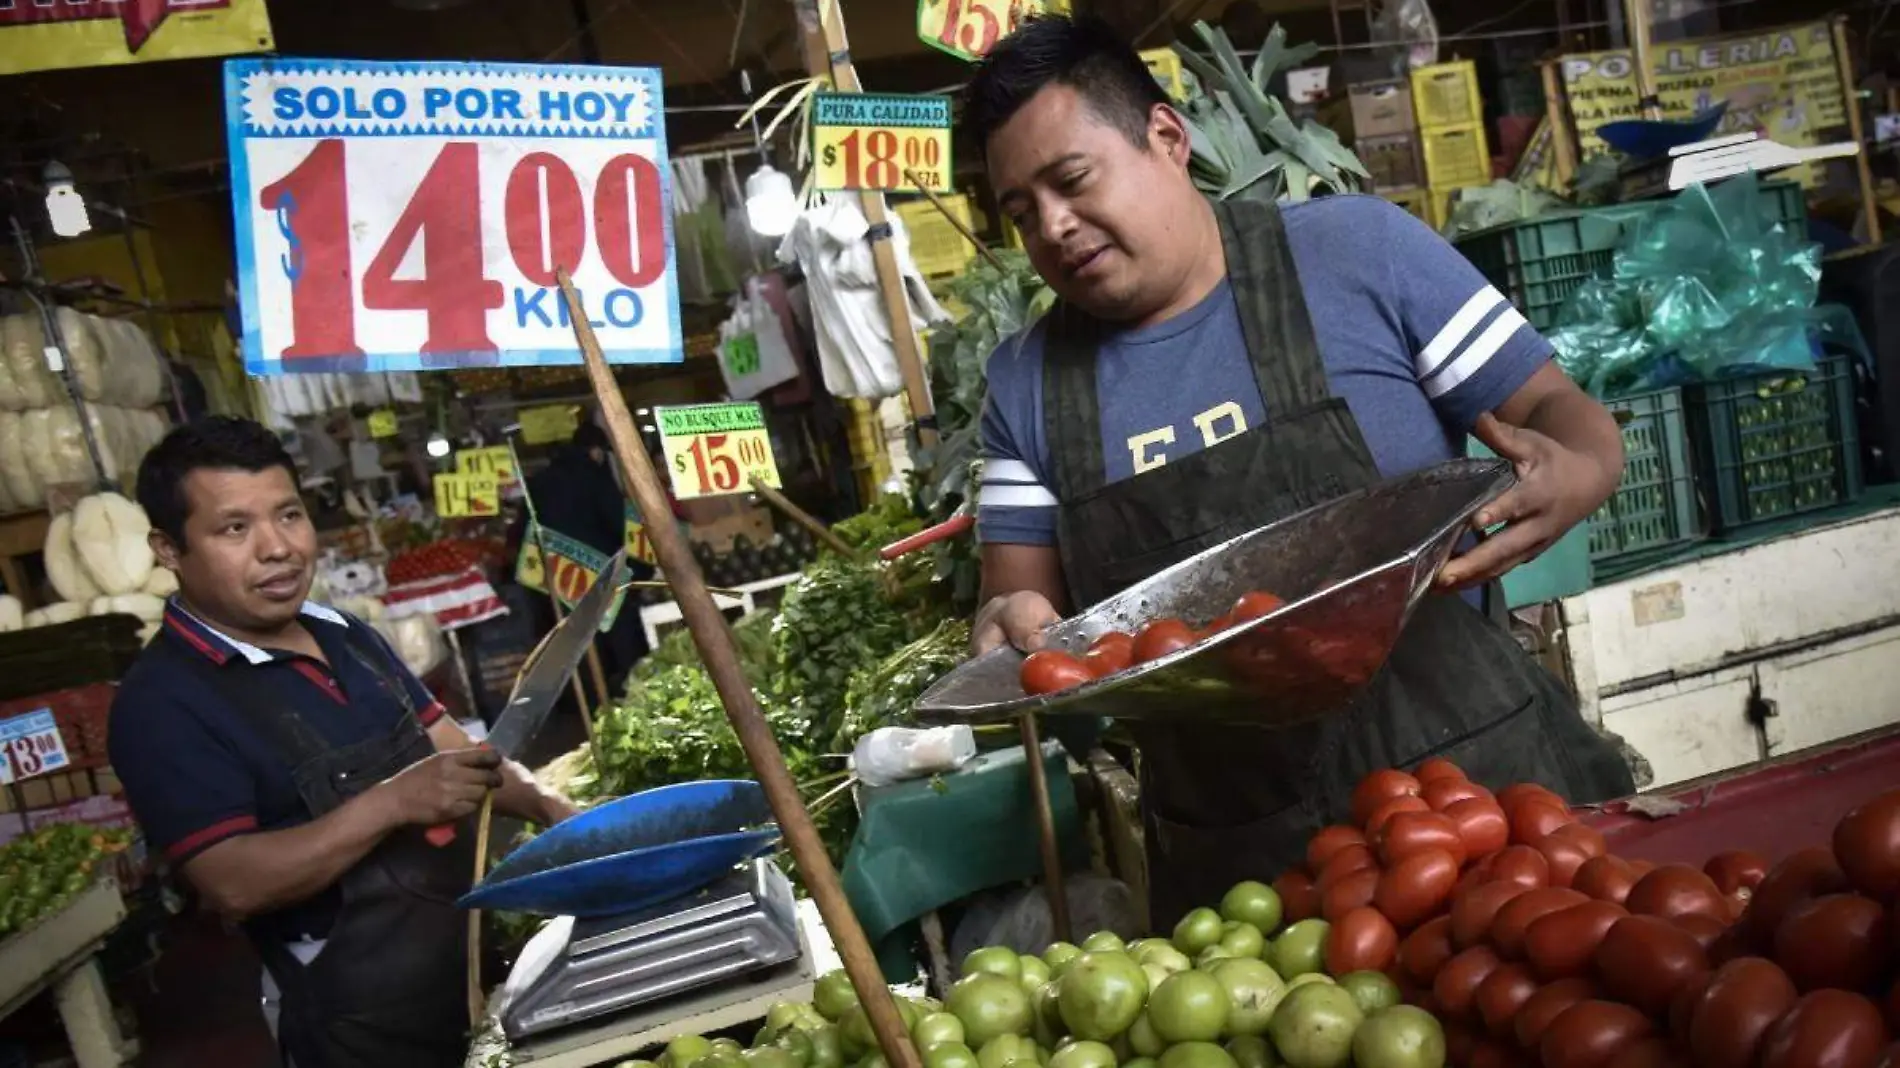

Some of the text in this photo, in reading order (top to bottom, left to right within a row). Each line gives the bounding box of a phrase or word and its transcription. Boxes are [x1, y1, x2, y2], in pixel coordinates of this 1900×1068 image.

[1563, 34, 1798, 82] POLERIA
[272, 86, 636, 123] SOLO POR HOY
[821, 103, 944, 120] PURA CALIDAD
[663, 413, 683, 429] NO
[684, 409, 733, 428] BUSQUE
